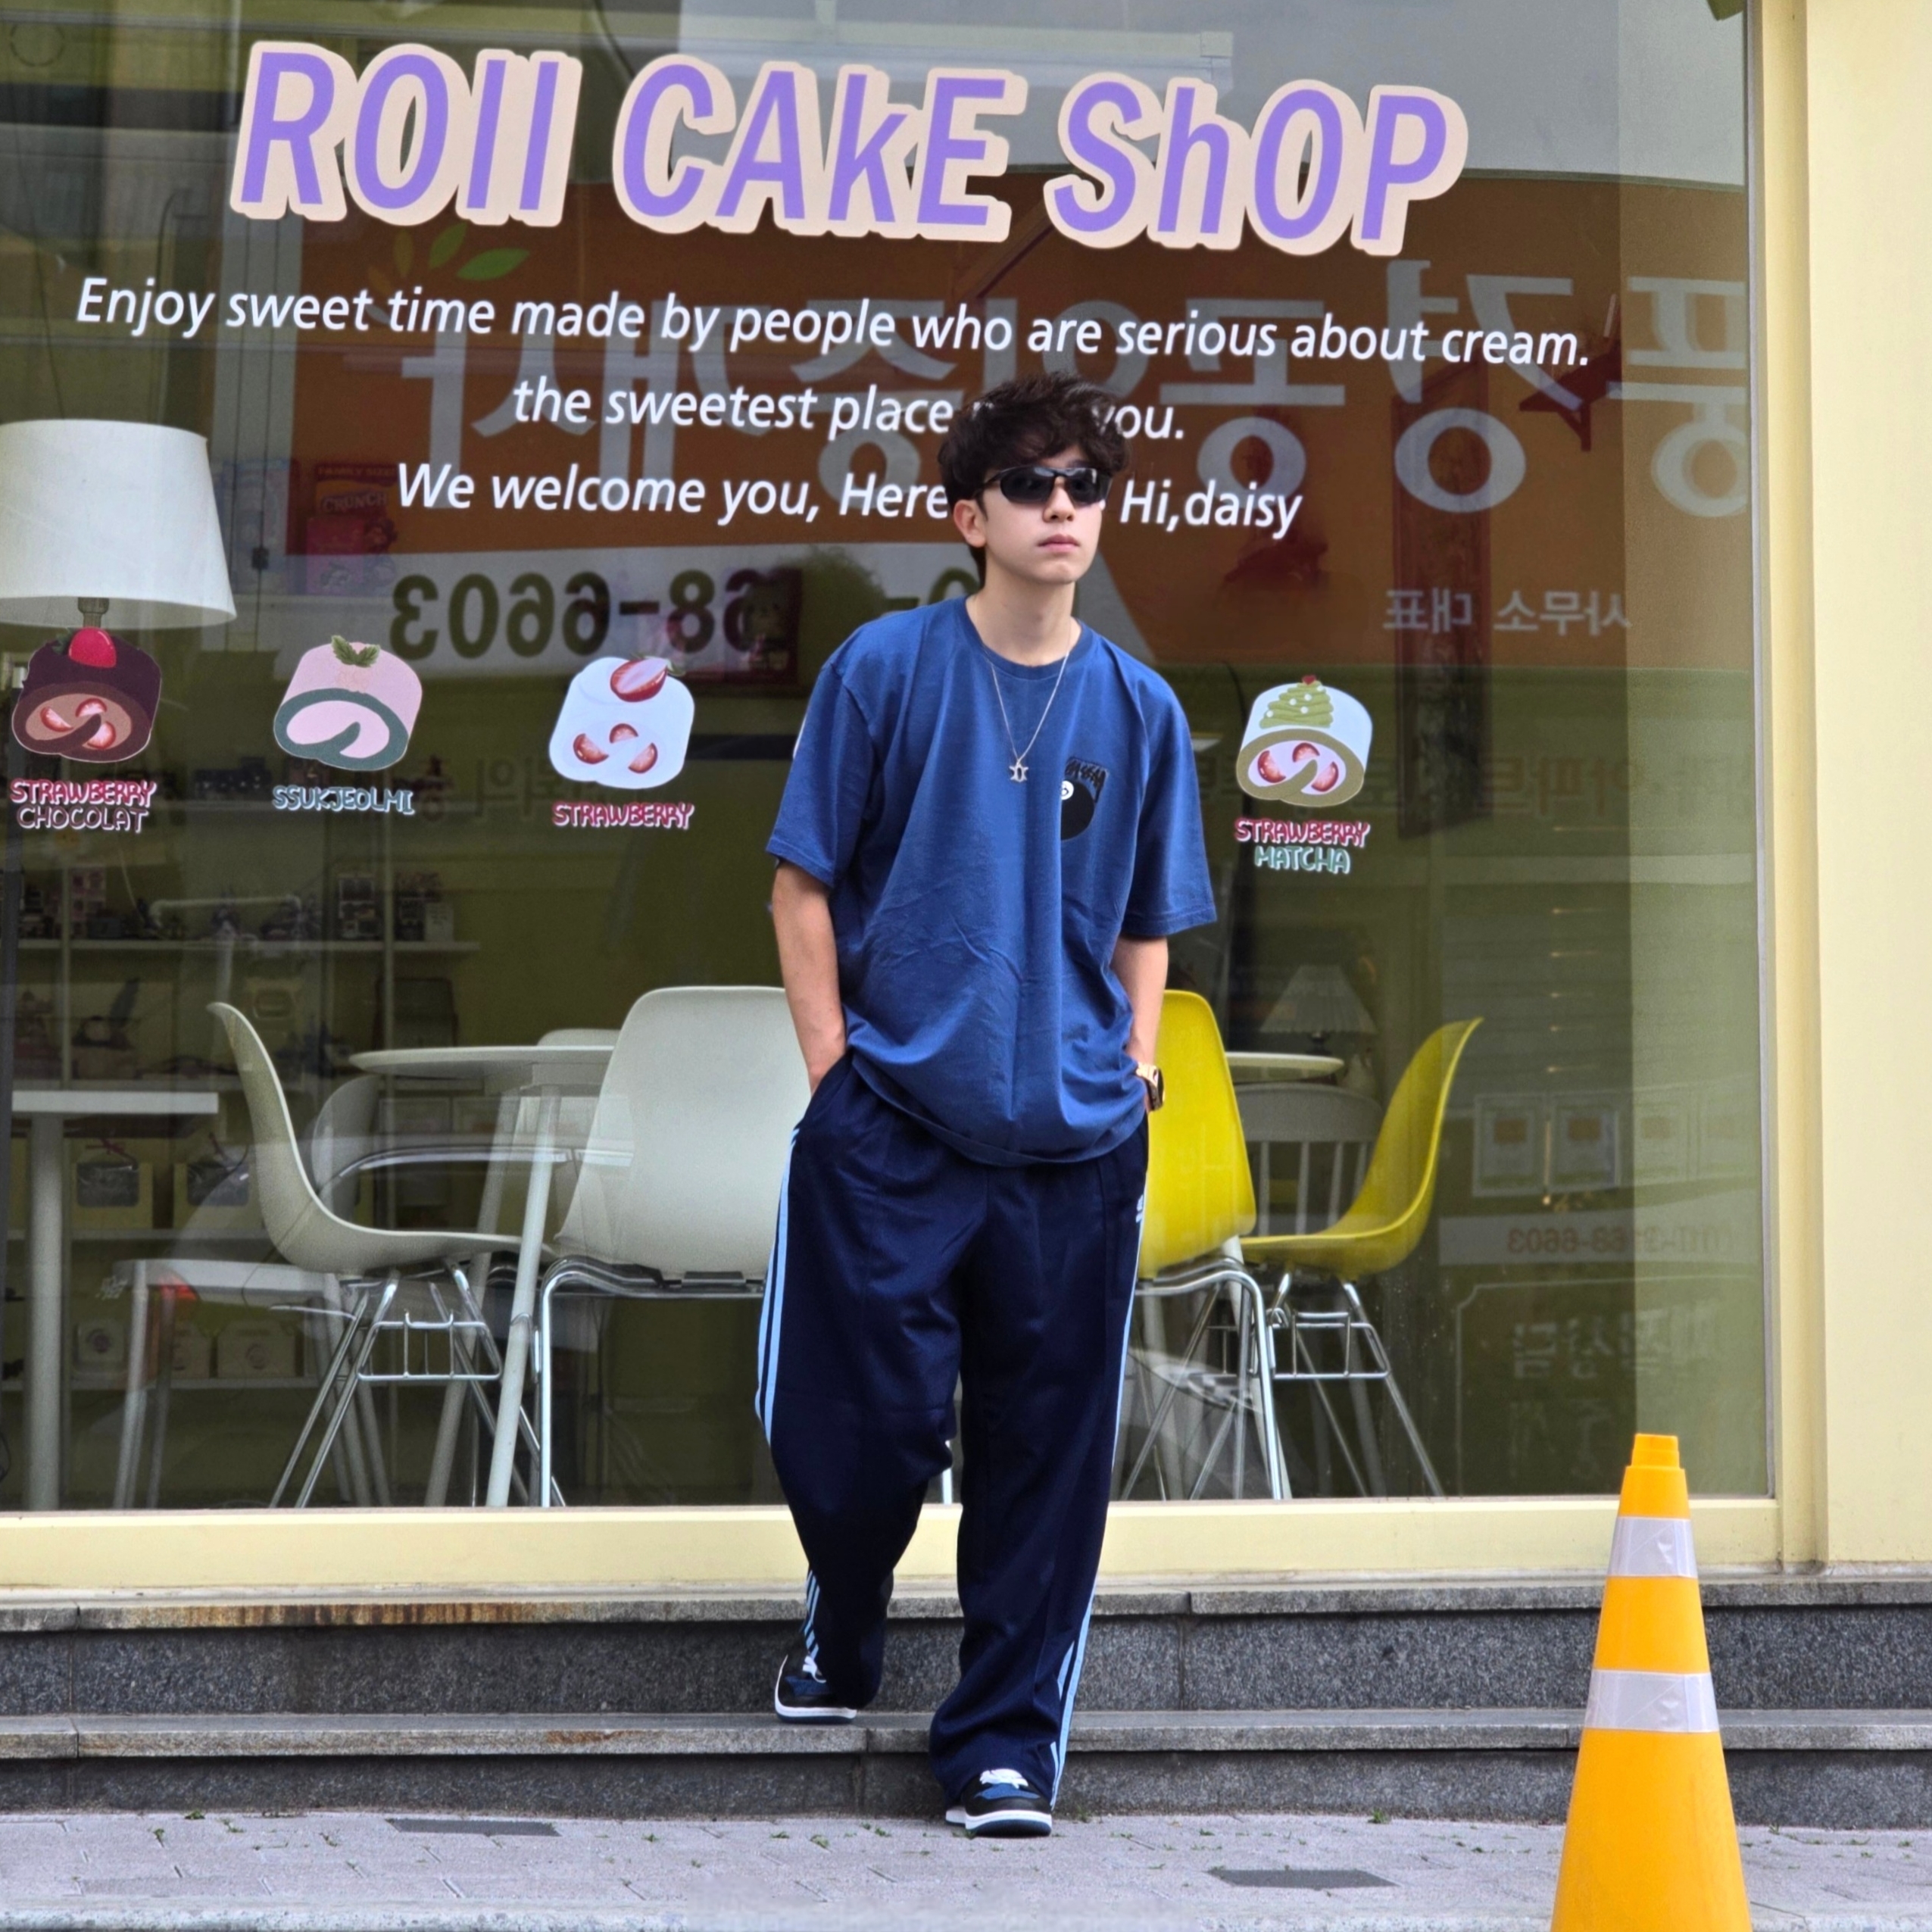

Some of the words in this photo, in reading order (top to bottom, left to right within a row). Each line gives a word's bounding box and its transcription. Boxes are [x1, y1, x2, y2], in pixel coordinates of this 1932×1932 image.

[1045, 73, 1467, 255] ShOP
[77, 277, 215, 339] Enjoy
[226, 290, 373, 331] sweet
[388, 286, 495, 334] time
[511, 291, 645, 339] made
[660, 292, 720, 352] by
[729, 298, 895, 355] people
[912, 303, 1013, 351] who
[1028, 319, 1102, 354] are
[1116, 310, 1278, 357] serious
[1291, 313, 1429, 362] about
[1442, 329, 1588, 366] cream.
[513, 375, 591, 423] the
[604, 386, 818, 429] sweetest
[829, 384, 954, 442] place
[399, 463, 474, 509] We
[492, 463, 705, 513] welcome
[717, 481, 819, 526] you,
[1120, 479, 1303, 539] Hi,daisy
[10, 778, 158, 808] STRAWBERRY
[272, 785, 416, 815] SSUKJEOLMI
[17, 804, 149, 833] CHOCOLAT
[552, 801, 695, 830] STRAWBERRY
[1234, 817, 1371, 848] STRAWBERRY
